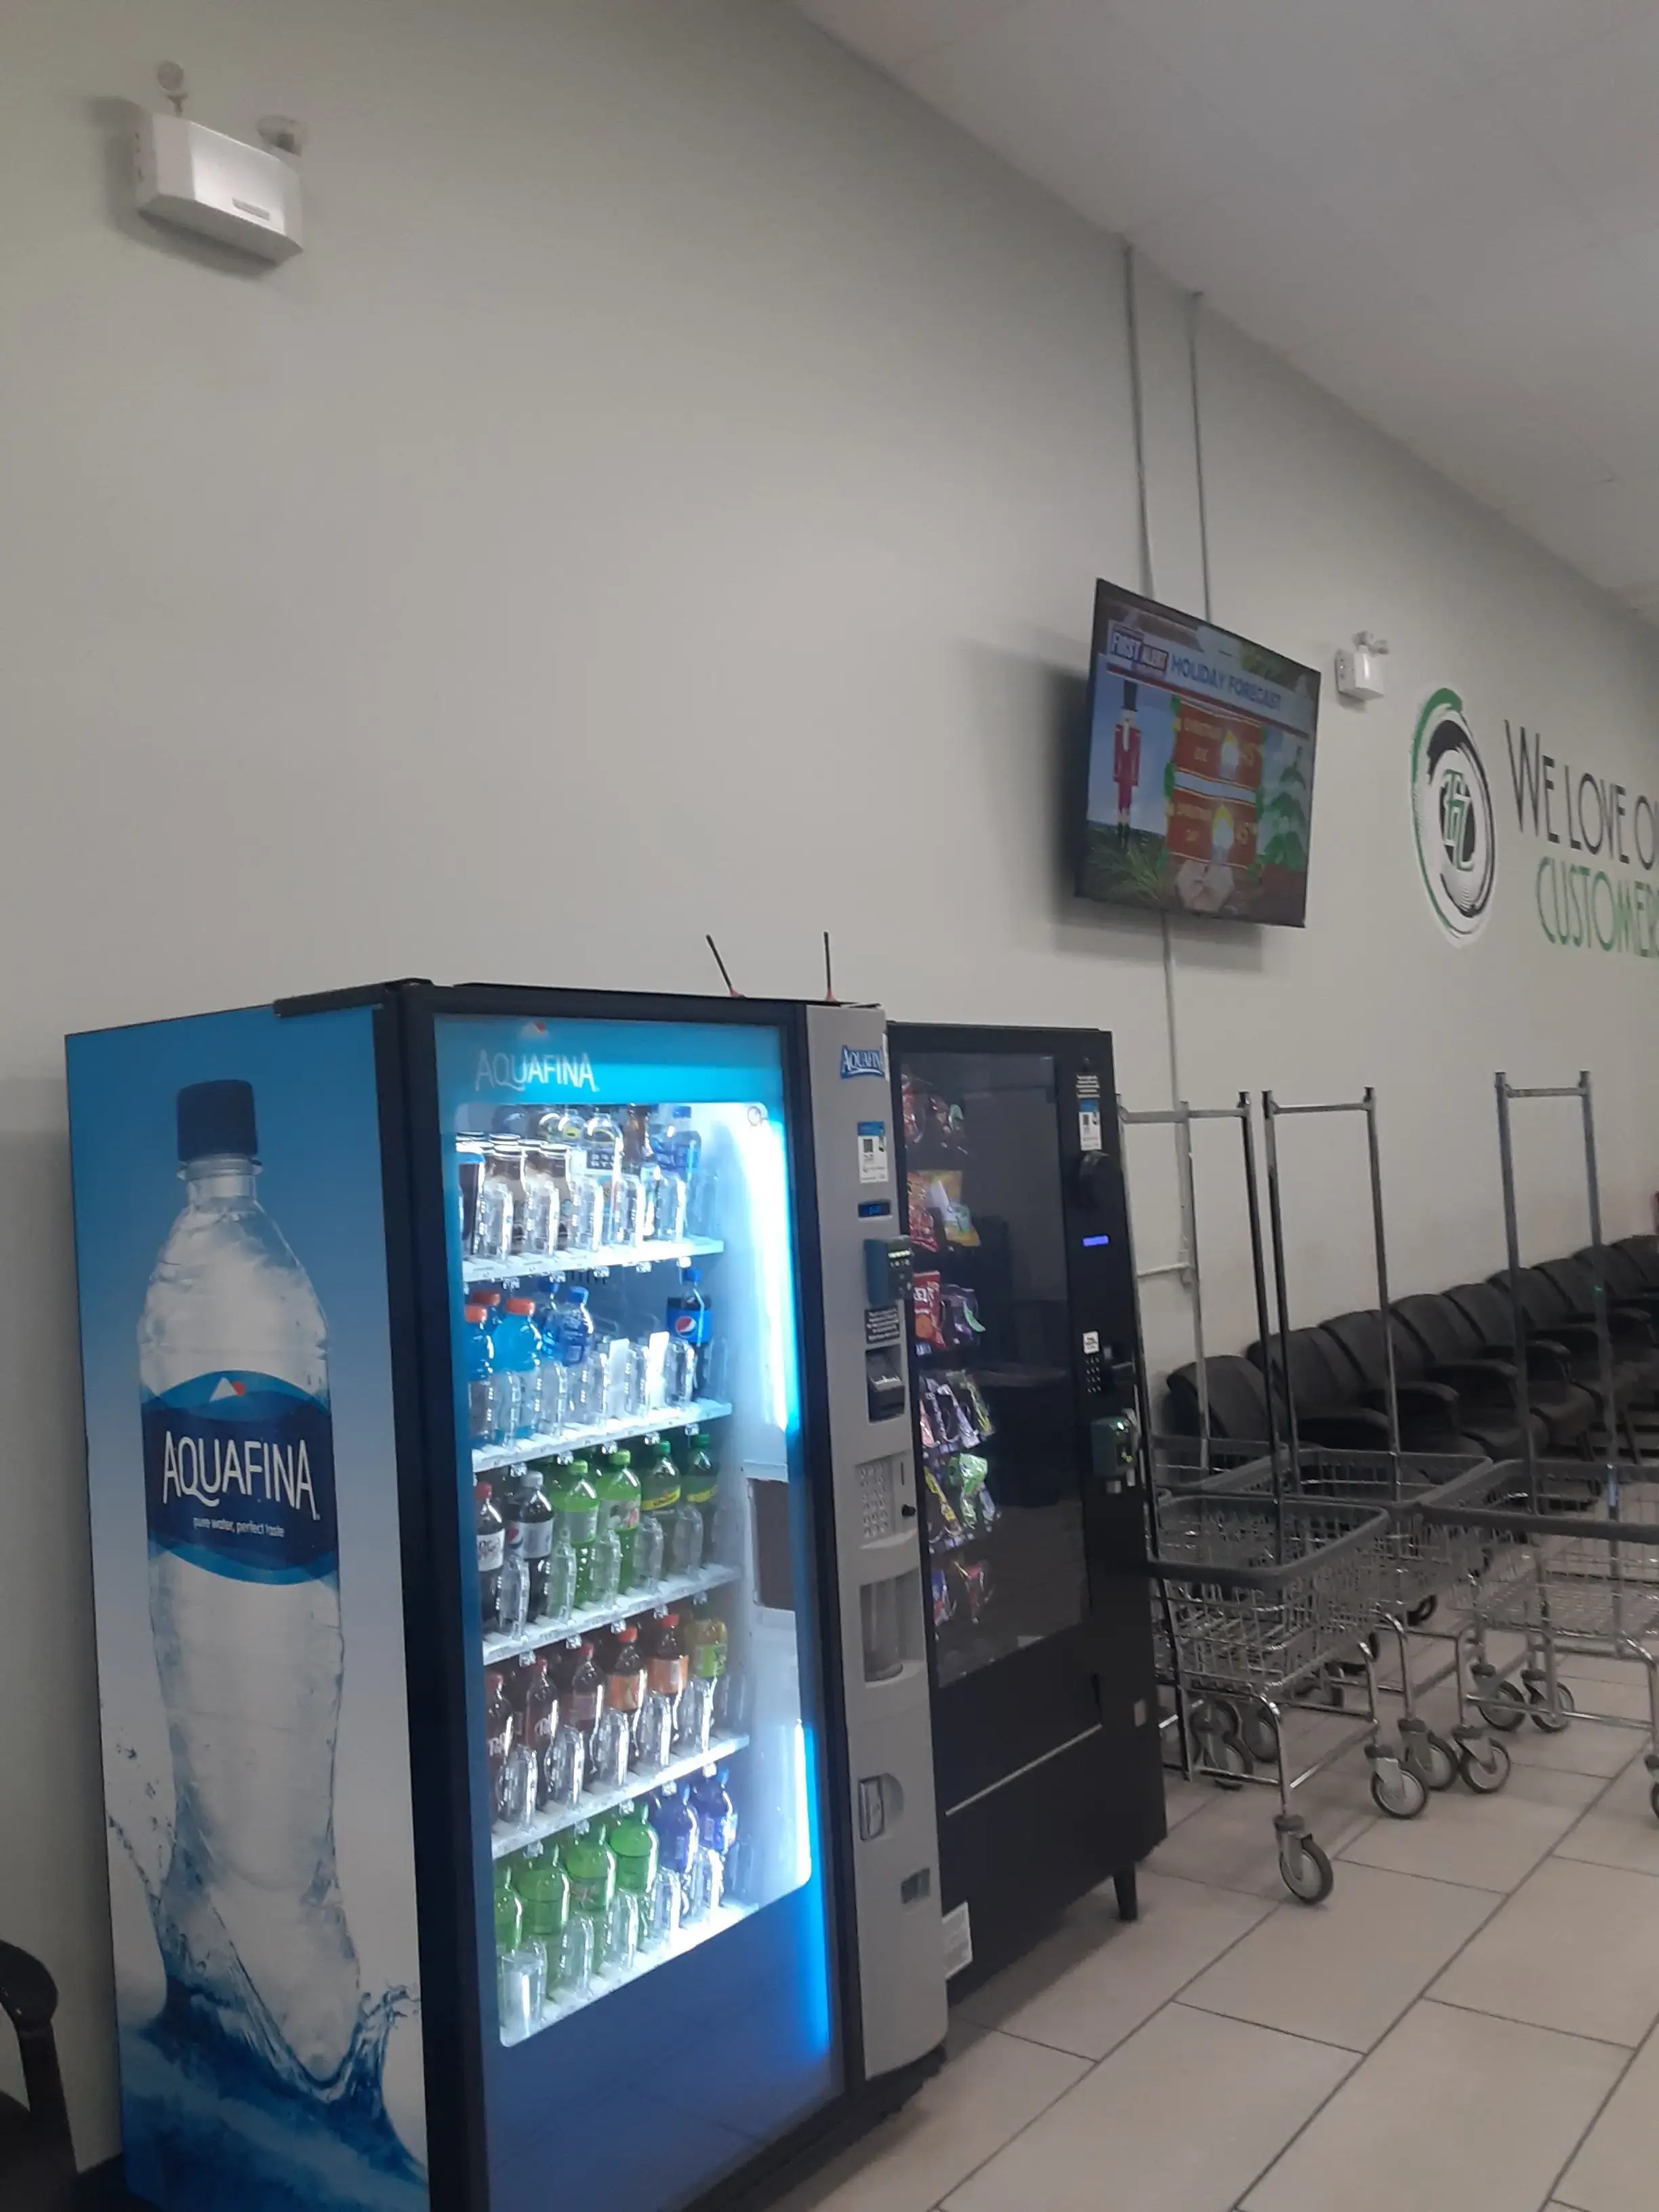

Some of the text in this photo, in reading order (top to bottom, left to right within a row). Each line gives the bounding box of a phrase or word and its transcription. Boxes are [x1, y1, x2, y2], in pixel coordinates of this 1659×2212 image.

[1170, 653, 1282, 710] HOLIDAY FORECAST
[1504, 718, 1560, 845] WE
[1563, 764, 1630, 865] LOVE
[1633, 794, 1658, 871] O
[475, 1048, 598, 1092] AQUAFINA
[162, 1430, 320, 1521] AQUAFINA
[192, 1517, 210, 1530] pure
[236, 1519, 265, 1535] perfect
[265, 1522, 285, 1538] taste
